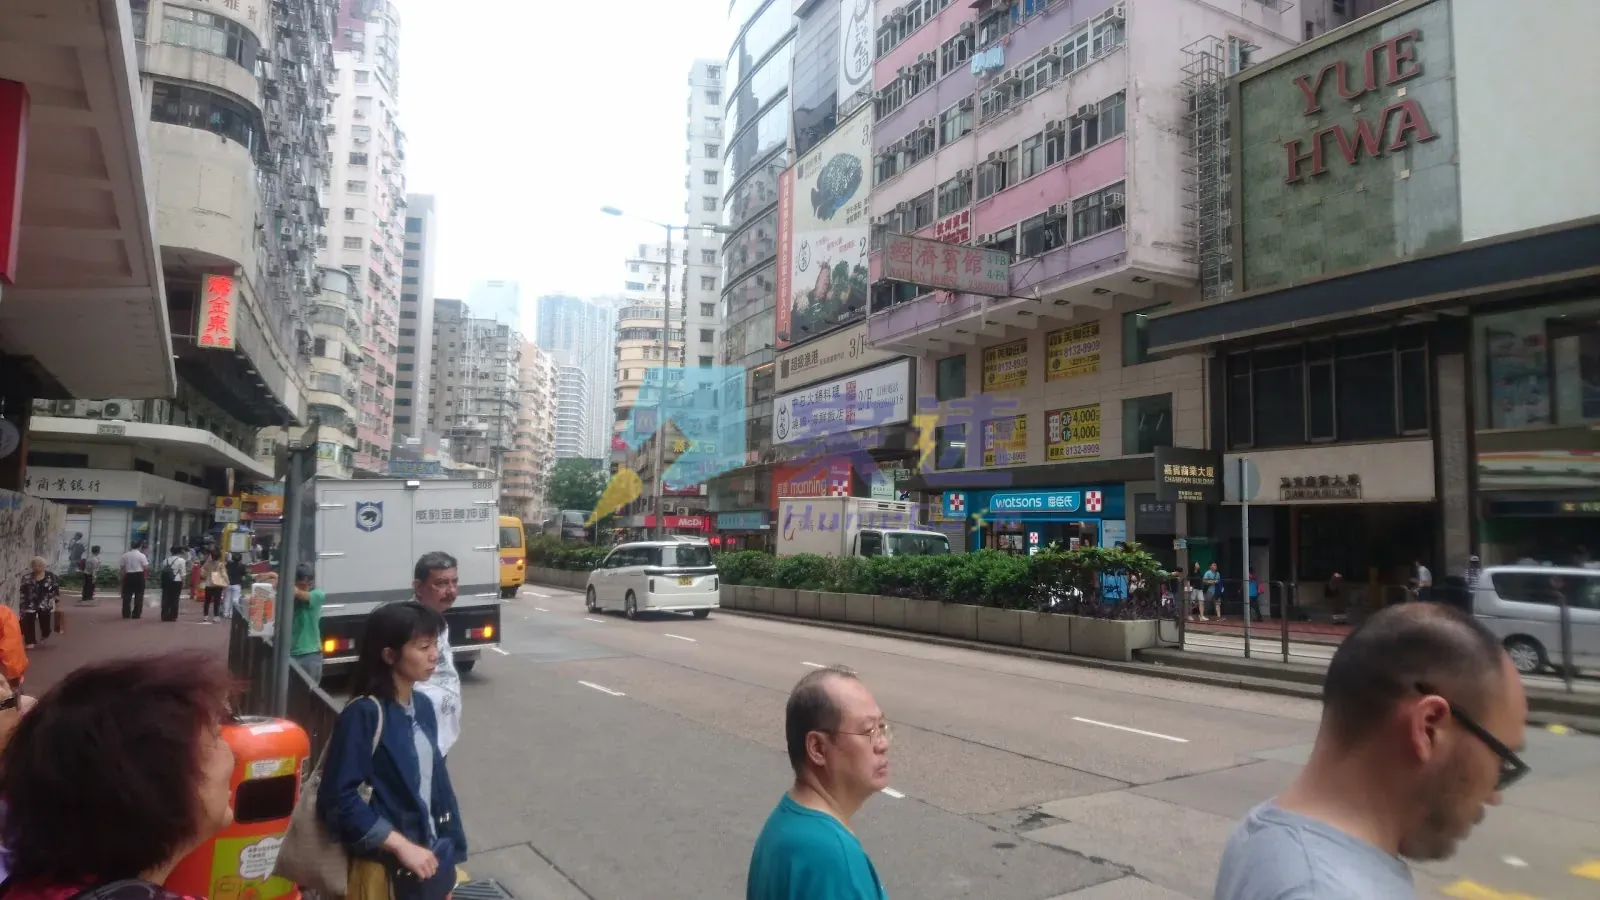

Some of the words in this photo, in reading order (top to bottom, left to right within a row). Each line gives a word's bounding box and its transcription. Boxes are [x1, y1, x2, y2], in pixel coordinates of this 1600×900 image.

[1293, 29, 1424, 116] YUE
[1284, 98, 1438, 184] HWA
[889, 241, 984, 275] 經濟賓館
[1064, 340, 1100, 357] 8132-8909
[1073, 409, 1096, 426] 4,000
[1073, 426, 1096, 443] 4,000
[1065, 444, 1100, 456] 8132-8909
[1164, 475, 1192, 484] CHAMPION
[1192, 477, 1215, 486] BUILDING
[996, 497, 1042, 508] watsons
[1048, 495, 1073, 508] 屈臣氏
